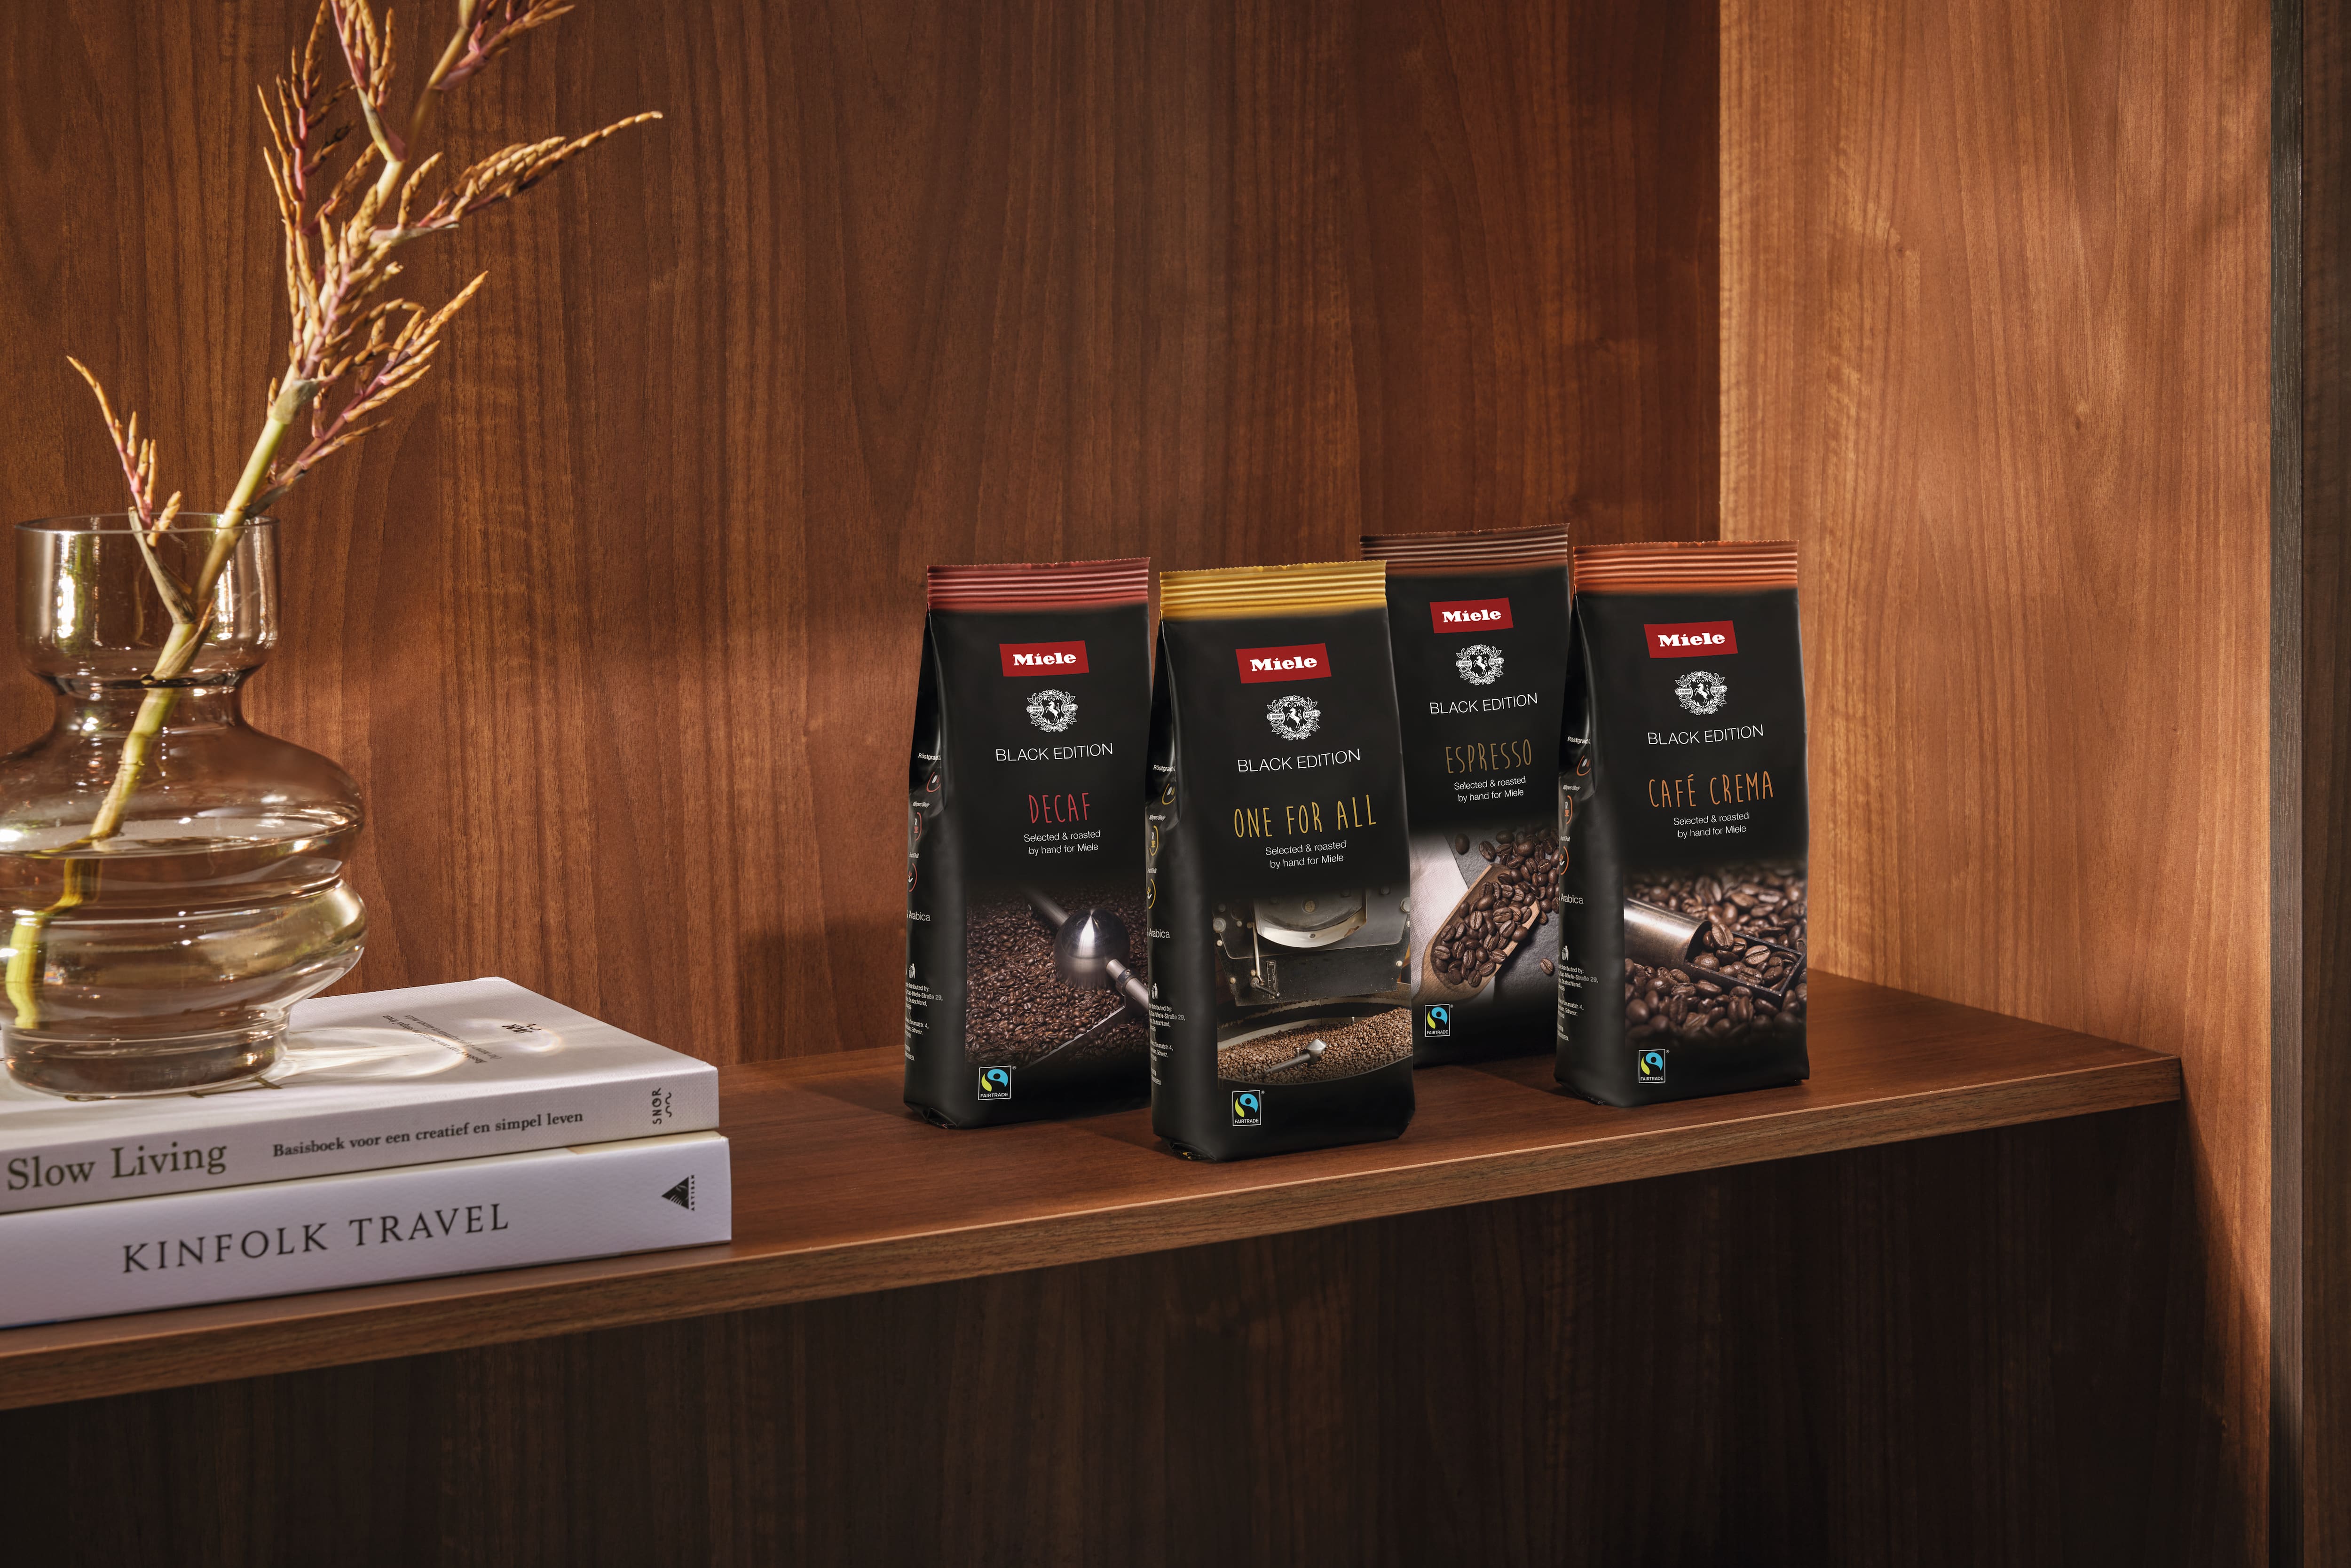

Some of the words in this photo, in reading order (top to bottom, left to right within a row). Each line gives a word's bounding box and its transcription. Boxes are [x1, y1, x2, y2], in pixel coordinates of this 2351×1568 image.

[1442, 609, 1501, 622] Miele
[1658, 632, 1725, 647] Miele
[1013, 653, 1076, 666] Miele
[1250, 656, 1317, 671] Miele
[1430, 700, 1478, 714] BLACK
[1483, 693, 1538, 711] EDITION
[1648, 731, 1700, 745] BLACK
[1704, 724, 1764, 743] EDITION
[996, 748, 1049, 761] BLACK
[1053, 742, 1113, 760] EDITION
[1445, 739, 1531, 773] ESPRESSO
[1238, 757, 1293, 772] BLACK
[1297, 749, 1360, 769] EDITION
[1454, 780, 1487, 790] Selected
[1498, 776, 1526, 786] roasted
[1649, 774, 1696, 807] CAFÉ
[1710, 771, 1773, 805] CREMA
[1458, 794, 1467, 803] by
[1469, 792, 1489, 801] hand
[1504, 788, 1524, 797] Miele
[1028, 793, 1090, 824] DECAF
[1234, 807, 1272, 838] ONE
[1286, 802, 1322, 835] FOR
[1337, 795, 1376, 830] ALL
[1673, 816, 1709, 826] Selected
[1719, 812, 1749, 822] roasted
[1024, 833, 1060, 842] Selected
[1070, 829, 1101, 839] roasted
[1678, 830, 1688, 839] by
[1690, 827, 1710, 837] hand
[1726, 825, 1746, 834] Miele
[1028, 847, 1039, 856] by
[1041, 845, 1062, 854] hand
[1064, 844, 1075, 853] for
[1077, 843, 1098, 851] Miele
[1265, 844, 1303, 856] Selected
[1306, 844, 1312, 852] &
[1314, 840, 1347, 851] roasted
[1270, 860, 1280, 870] by
[1283, 858, 1305, 867] hand
[1307, 857, 1318, 865] for
[1321, 854, 1344, 863] Miele
[1561, 893, 1584, 904] Arabica
[908, 910, 931, 922] Arabica
[1149, 928, 1170, 938] Arabica
[652, 1087, 662, 1124] SNOR
[7, 1156, 96, 1190] Slow
[110, 1142, 227, 1179] Living
[273, 1137, 345, 1157] Basisboek
[349, 1136, 381, 1148] voor
[386, 1133, 410, 1144] een
[416, 1122, 470, 1140] creatief
[473, 1124, 490, 1133] en
[495, 1114, 542, 1131] simpel
[547, 1113, 584, 1125] leven
[122, 1222, 329, 1273] KINFOLK
[349, 1204, 508, 1247] TRAVEL
